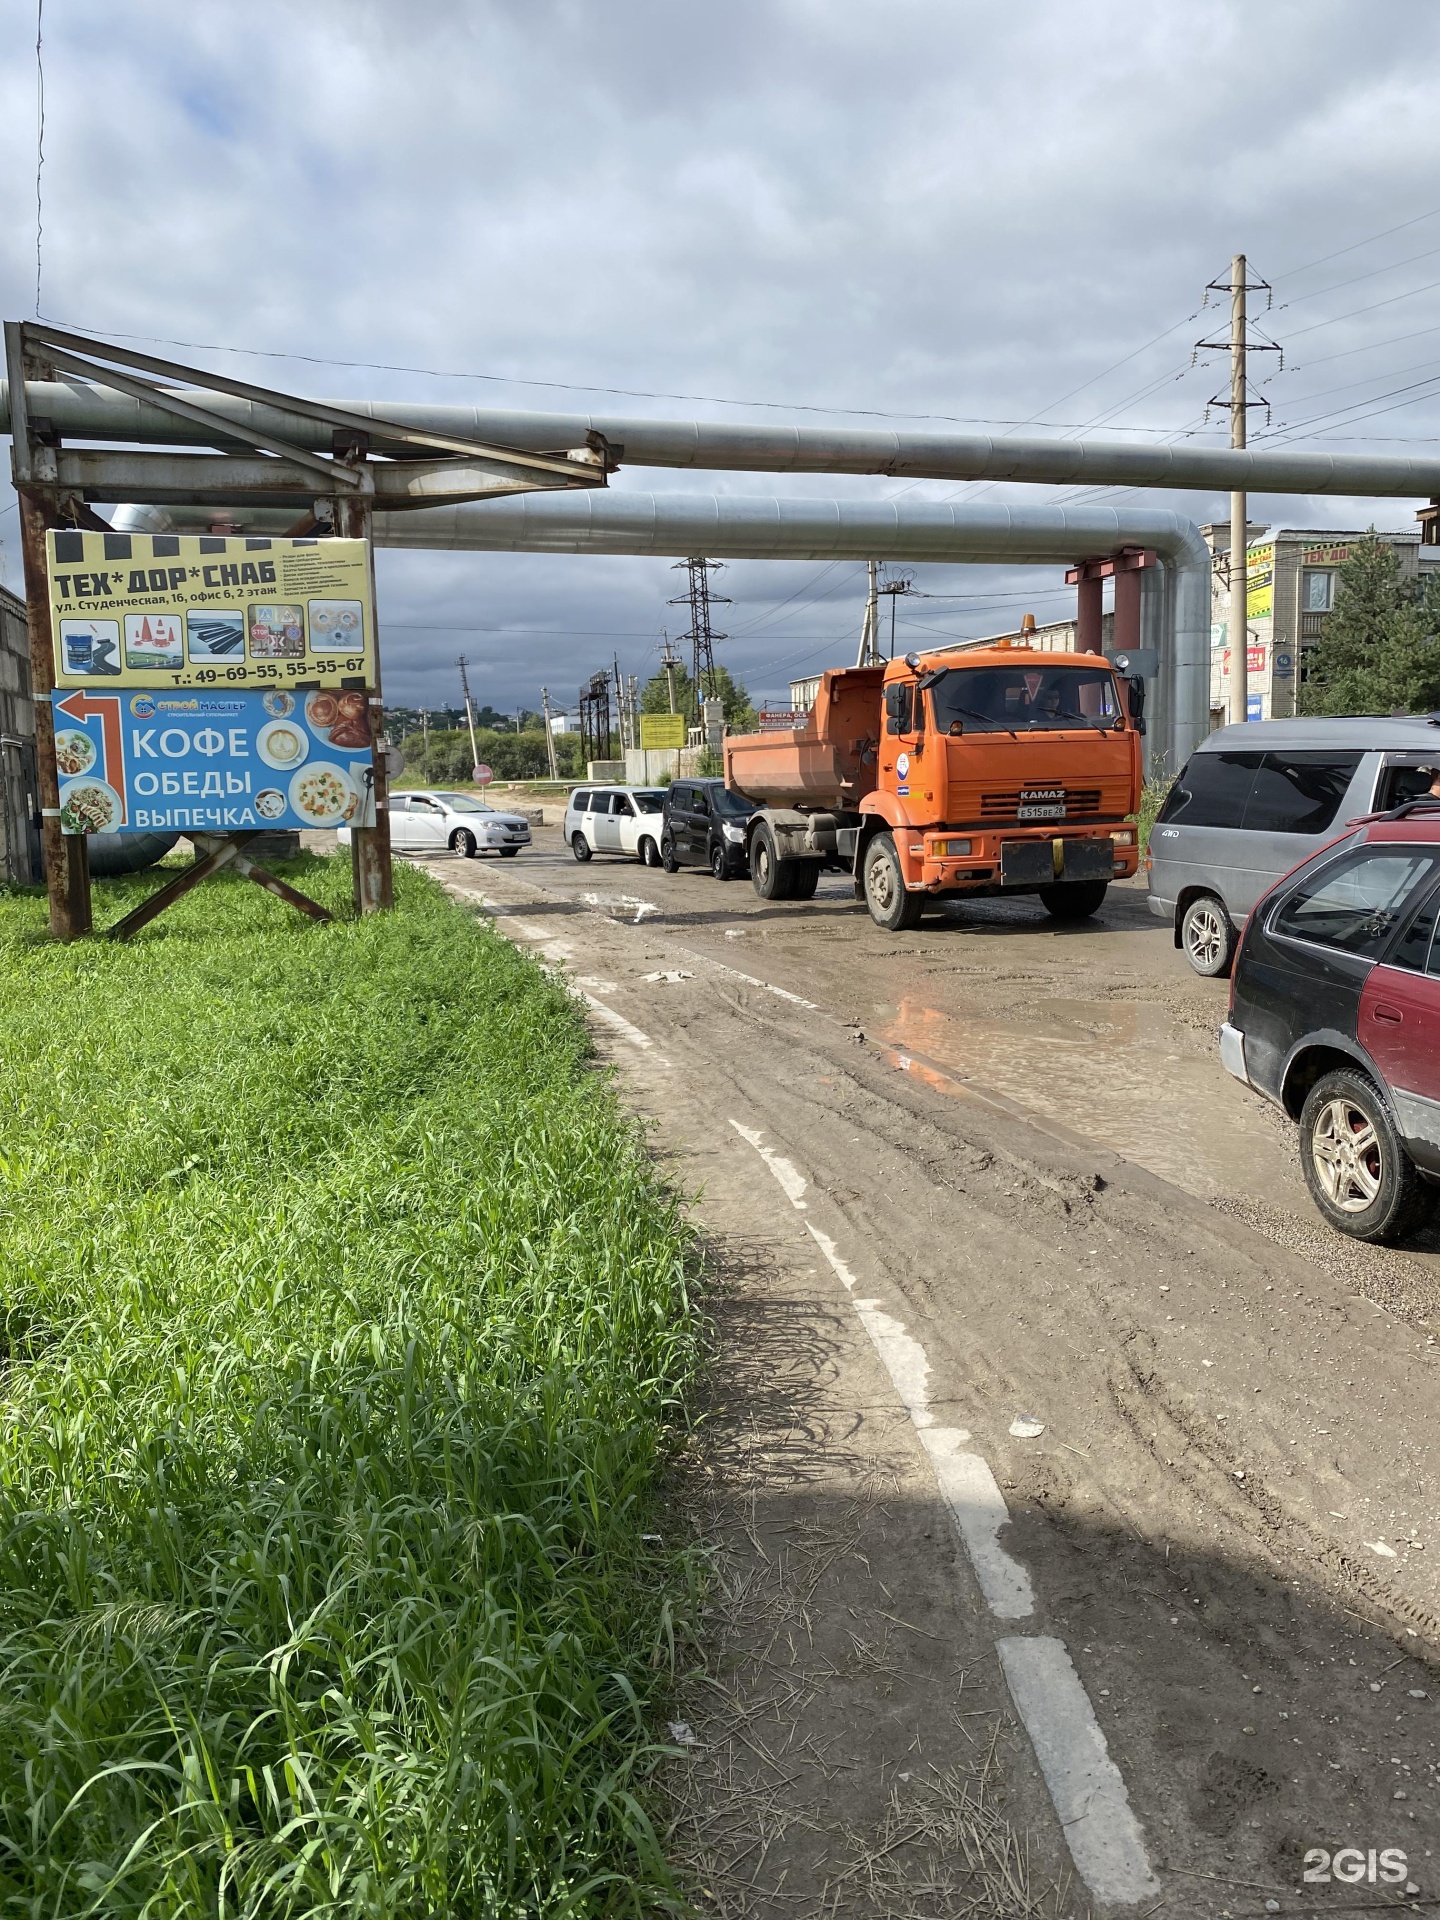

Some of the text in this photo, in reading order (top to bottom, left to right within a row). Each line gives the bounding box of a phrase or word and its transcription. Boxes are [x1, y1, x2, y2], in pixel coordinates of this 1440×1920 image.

[55, 587, 277, 613] ул. Студенческая, 16, офис 6, 2 этаж
[171, 658, 365, 685] т.: 49-69-55, 55-55-67
[157, 699, 247, 711] СТРОЙ МАСТЕР
[132, 727, 250, 758] КОФЕ
[134, 771, 251, 799] ОБЕДЫ
[1020, 790, 1065, 799] KAMAZ
[135, 807, 256, 828] ВЫПЕЧКА
[1161, 829, 1180, 838] 4WD
